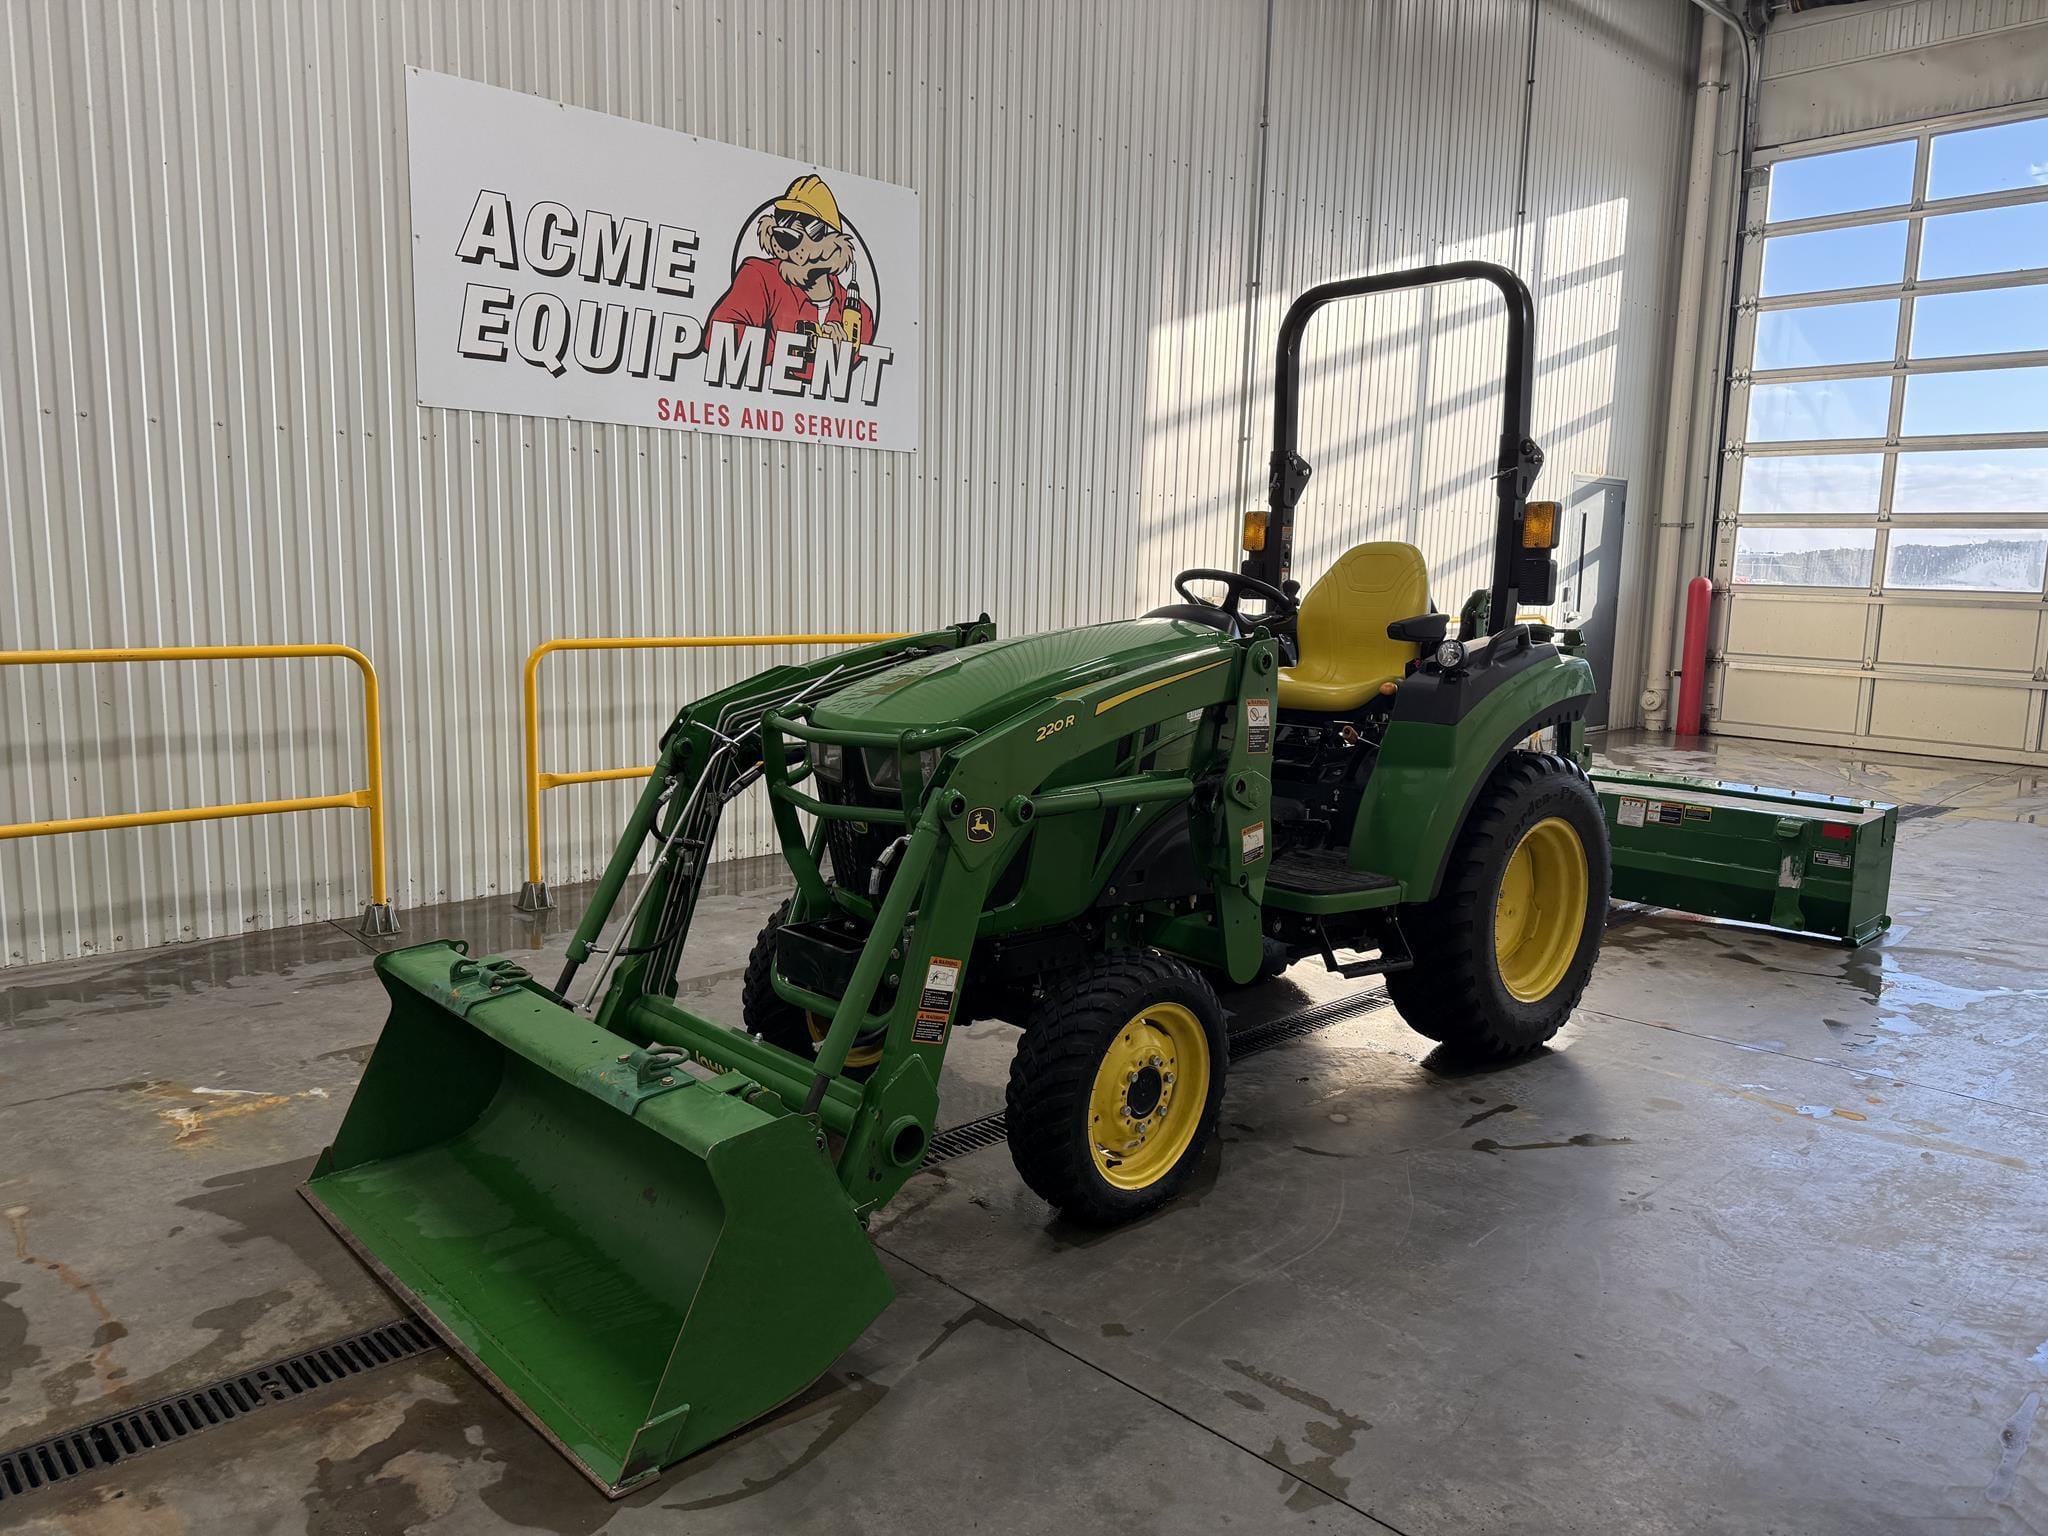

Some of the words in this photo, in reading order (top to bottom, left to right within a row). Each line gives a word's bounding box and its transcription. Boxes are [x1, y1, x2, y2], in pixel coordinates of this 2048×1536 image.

[455, 189, 700, 299] ACME
[457, 282, 894, 407] EQUIPMENT
[657, 397, 731, 428] SALES
[740, 407, 785, 433] AND
[794, 412, 879, 443] SERVICE
